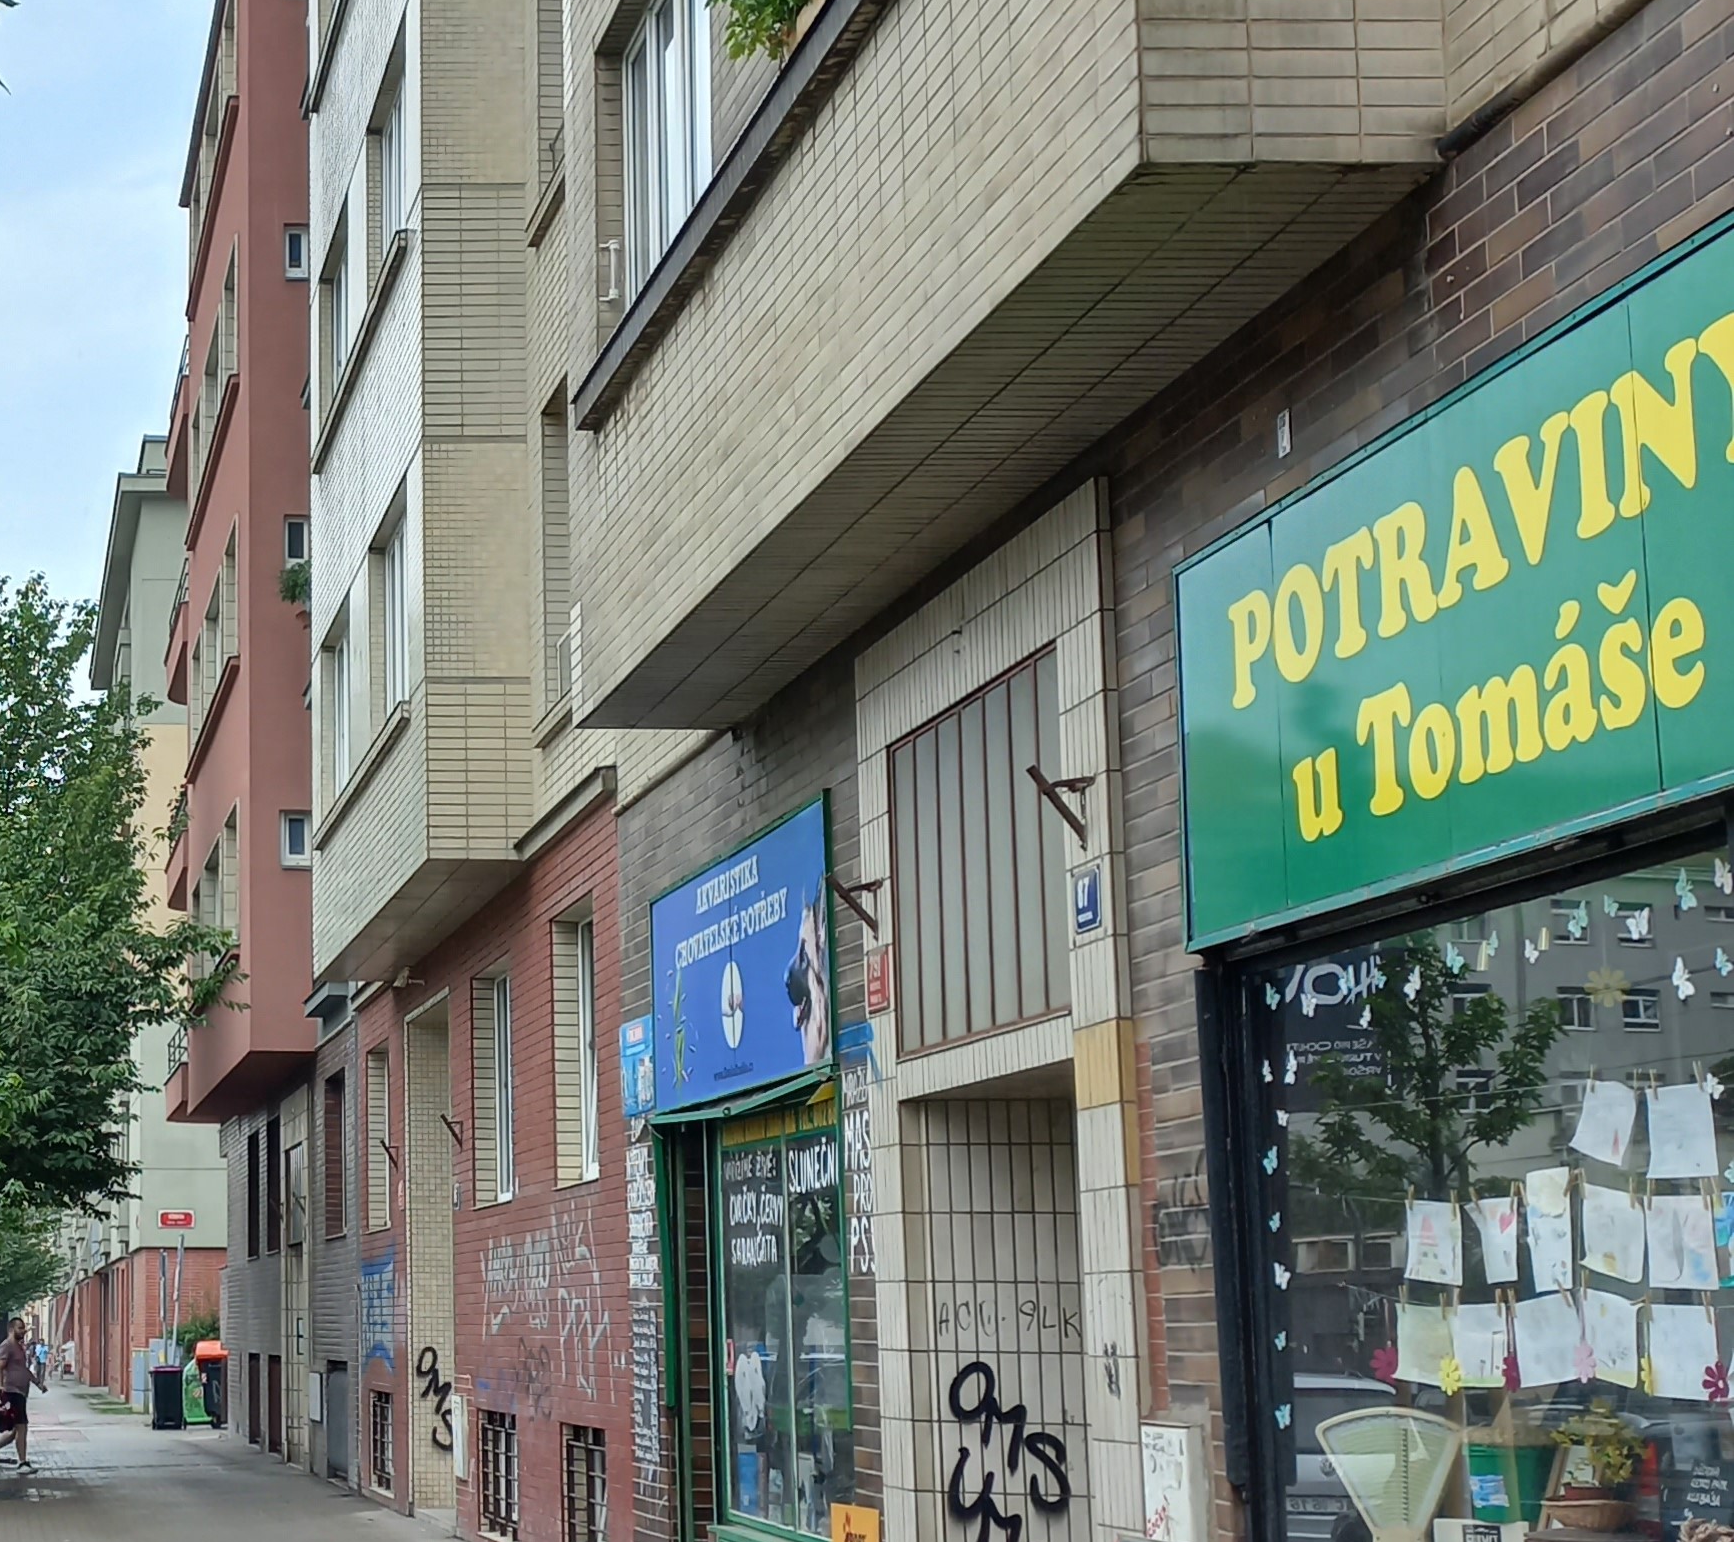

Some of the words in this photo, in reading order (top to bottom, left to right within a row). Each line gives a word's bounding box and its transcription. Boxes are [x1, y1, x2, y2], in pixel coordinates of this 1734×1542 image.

[1292, 746, 1344, 842] u
[1356, 568, 1706, 816] Tomáše
[695, 854, 759, 916] AKVARISTIKA
[675, 905, 741, 971] CHOVATELSKÉ
[740, 886, 788, 940] POTŘEBY
[844, 1111, 871, 1170] MAS
[853, 1173, 873, 1214] PRO
